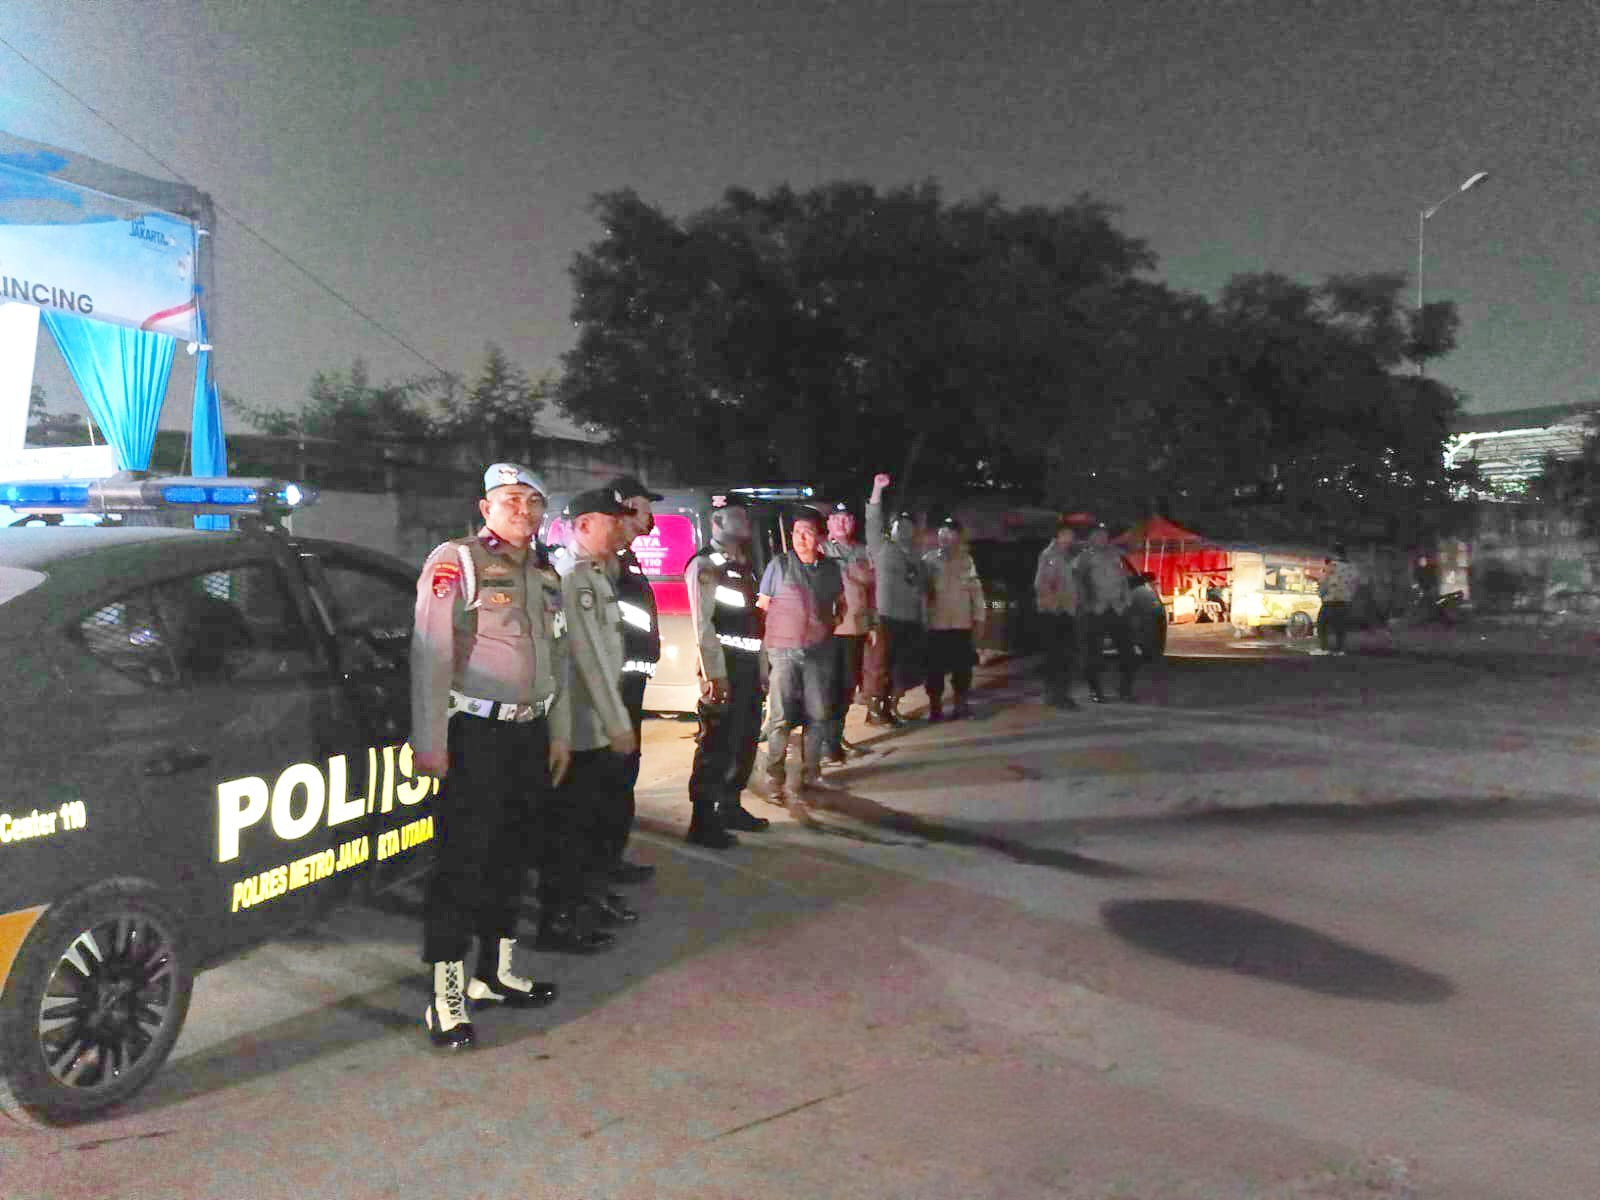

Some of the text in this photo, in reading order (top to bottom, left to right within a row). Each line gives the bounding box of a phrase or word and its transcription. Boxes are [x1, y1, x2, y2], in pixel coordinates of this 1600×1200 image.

[129, 221, 165, 245] JAKARTA
[0, 276, 93, 314] INCING
[218, 742, 439, 863] POLIS
[232, 865, 288, 913] POLRES
[288, 848, 335, 890] METRO
[400, 816, 435, 850] UTARA
